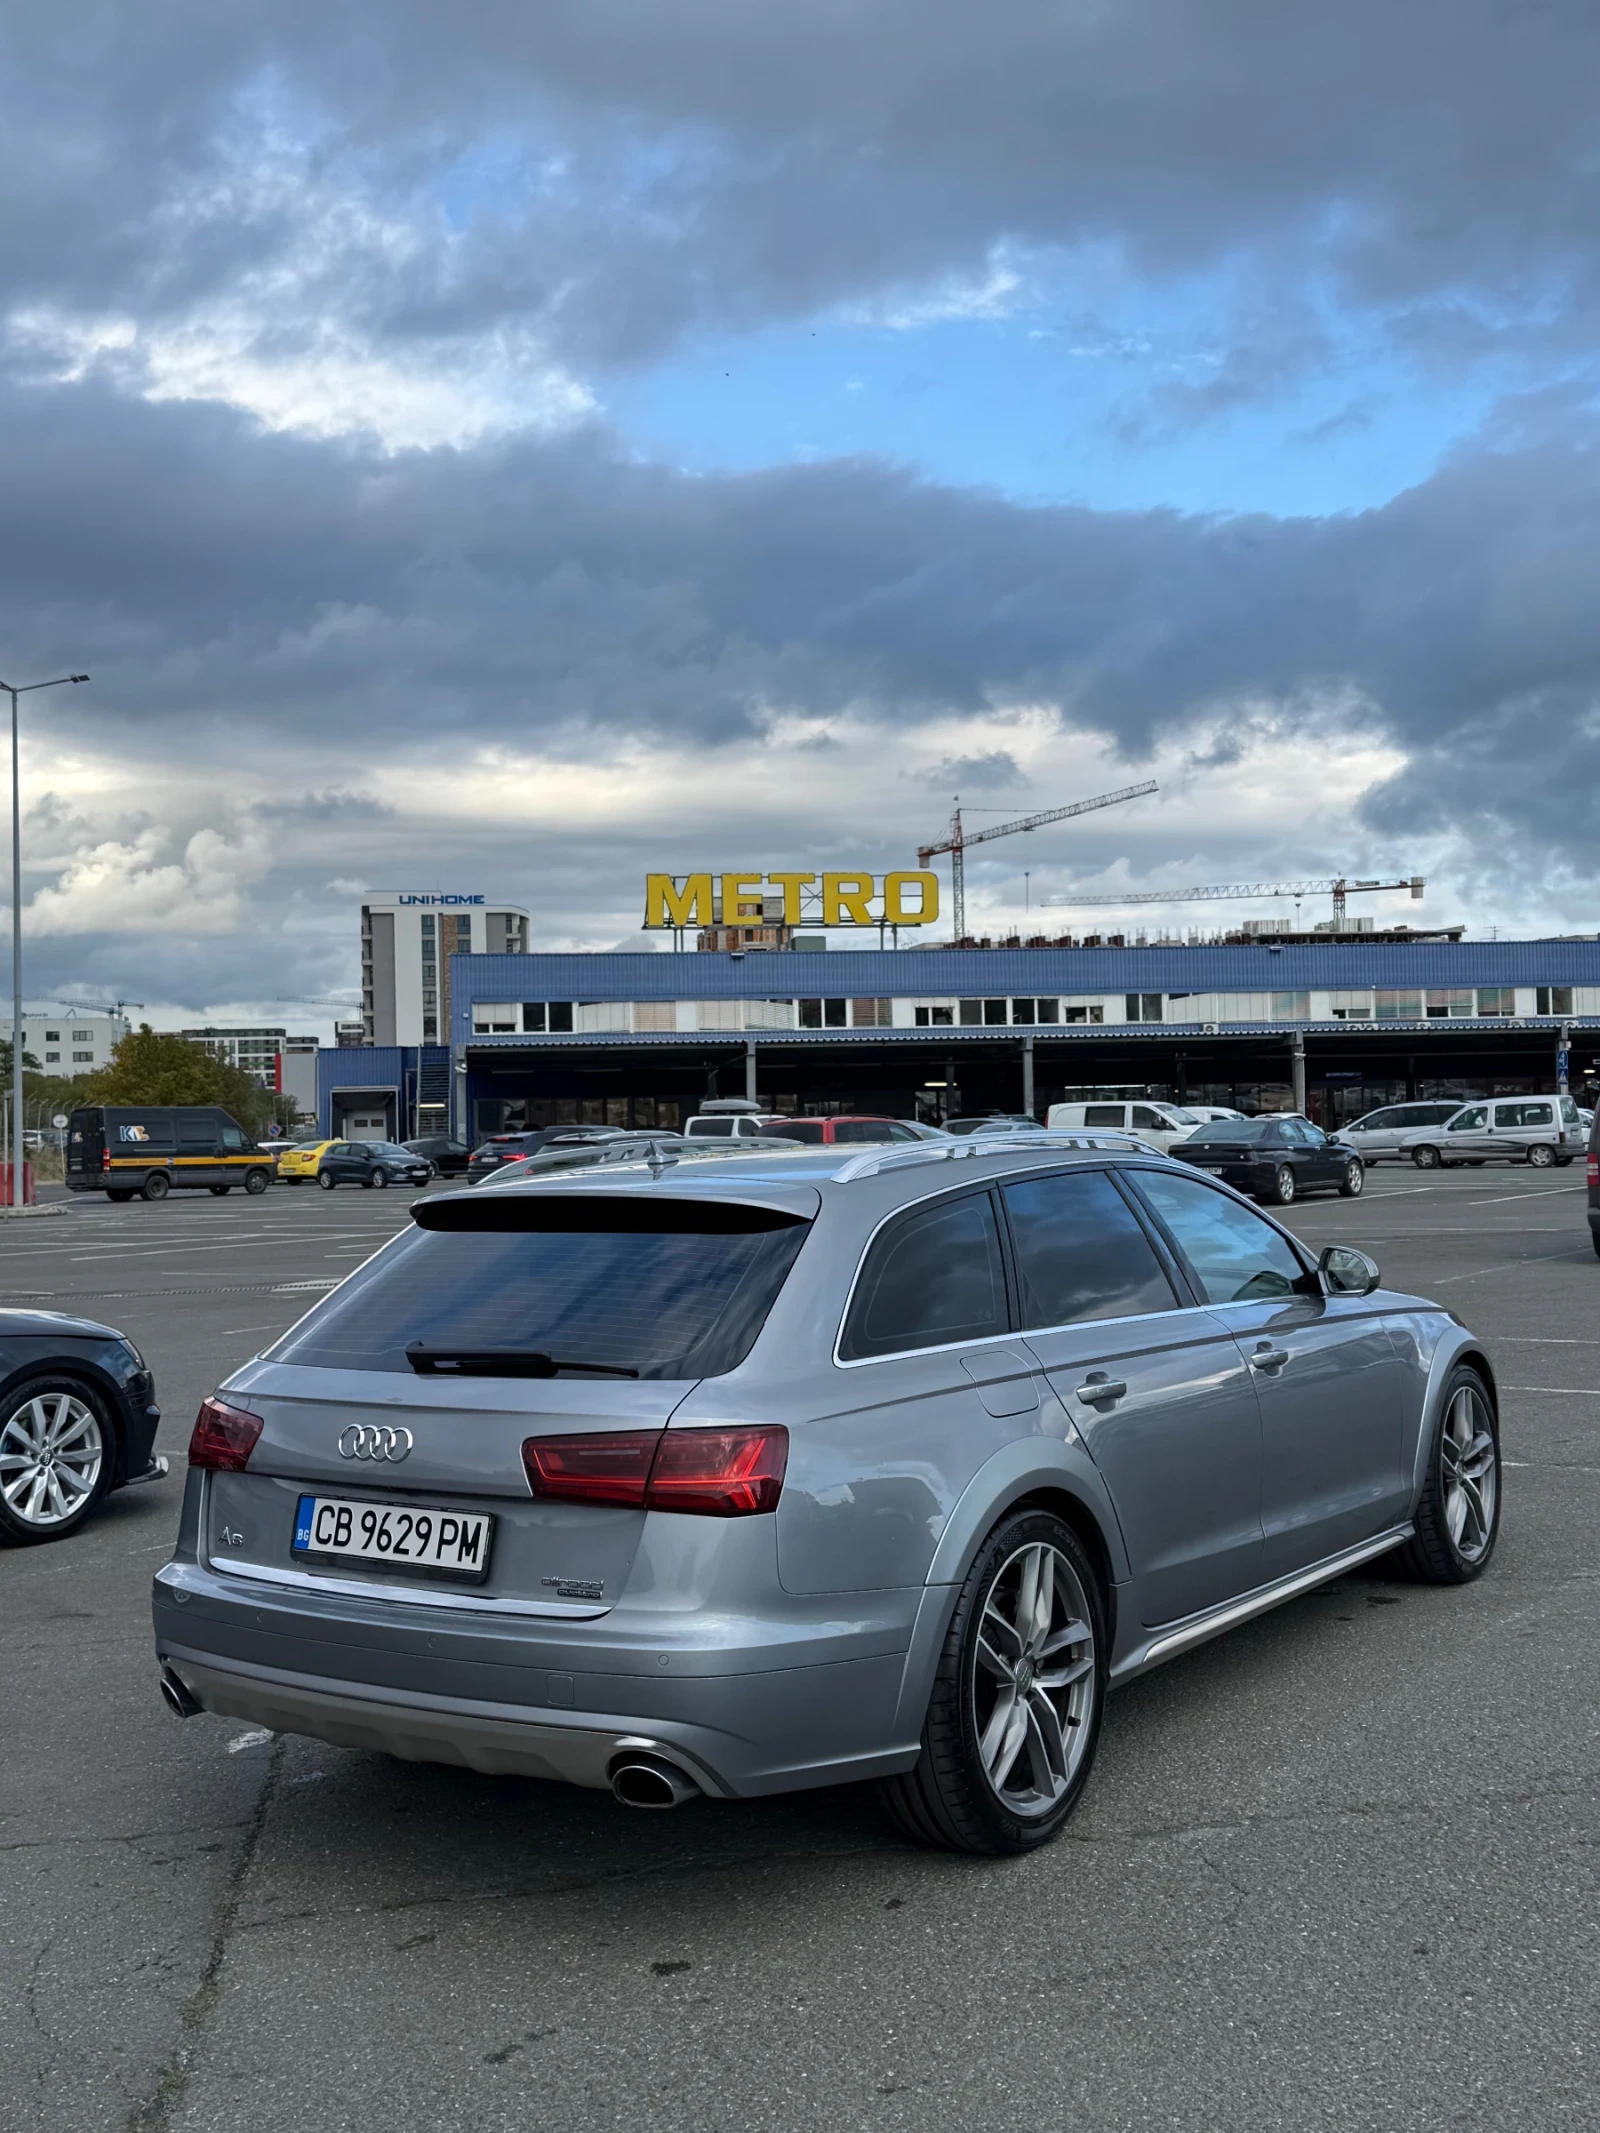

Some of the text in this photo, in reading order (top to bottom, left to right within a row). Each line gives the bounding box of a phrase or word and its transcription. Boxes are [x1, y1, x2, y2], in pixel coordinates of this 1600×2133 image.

[399, 895, 485, 905] UNIHOME
[646, 871, 939, 927] METRO
[218, 1526, 244, 1548] A6
[297, 1528, 310, 1542] BG
[315, 1505, 482, 1564] CB 9629 PM
[541, 1576, 604, 1590] allroad
